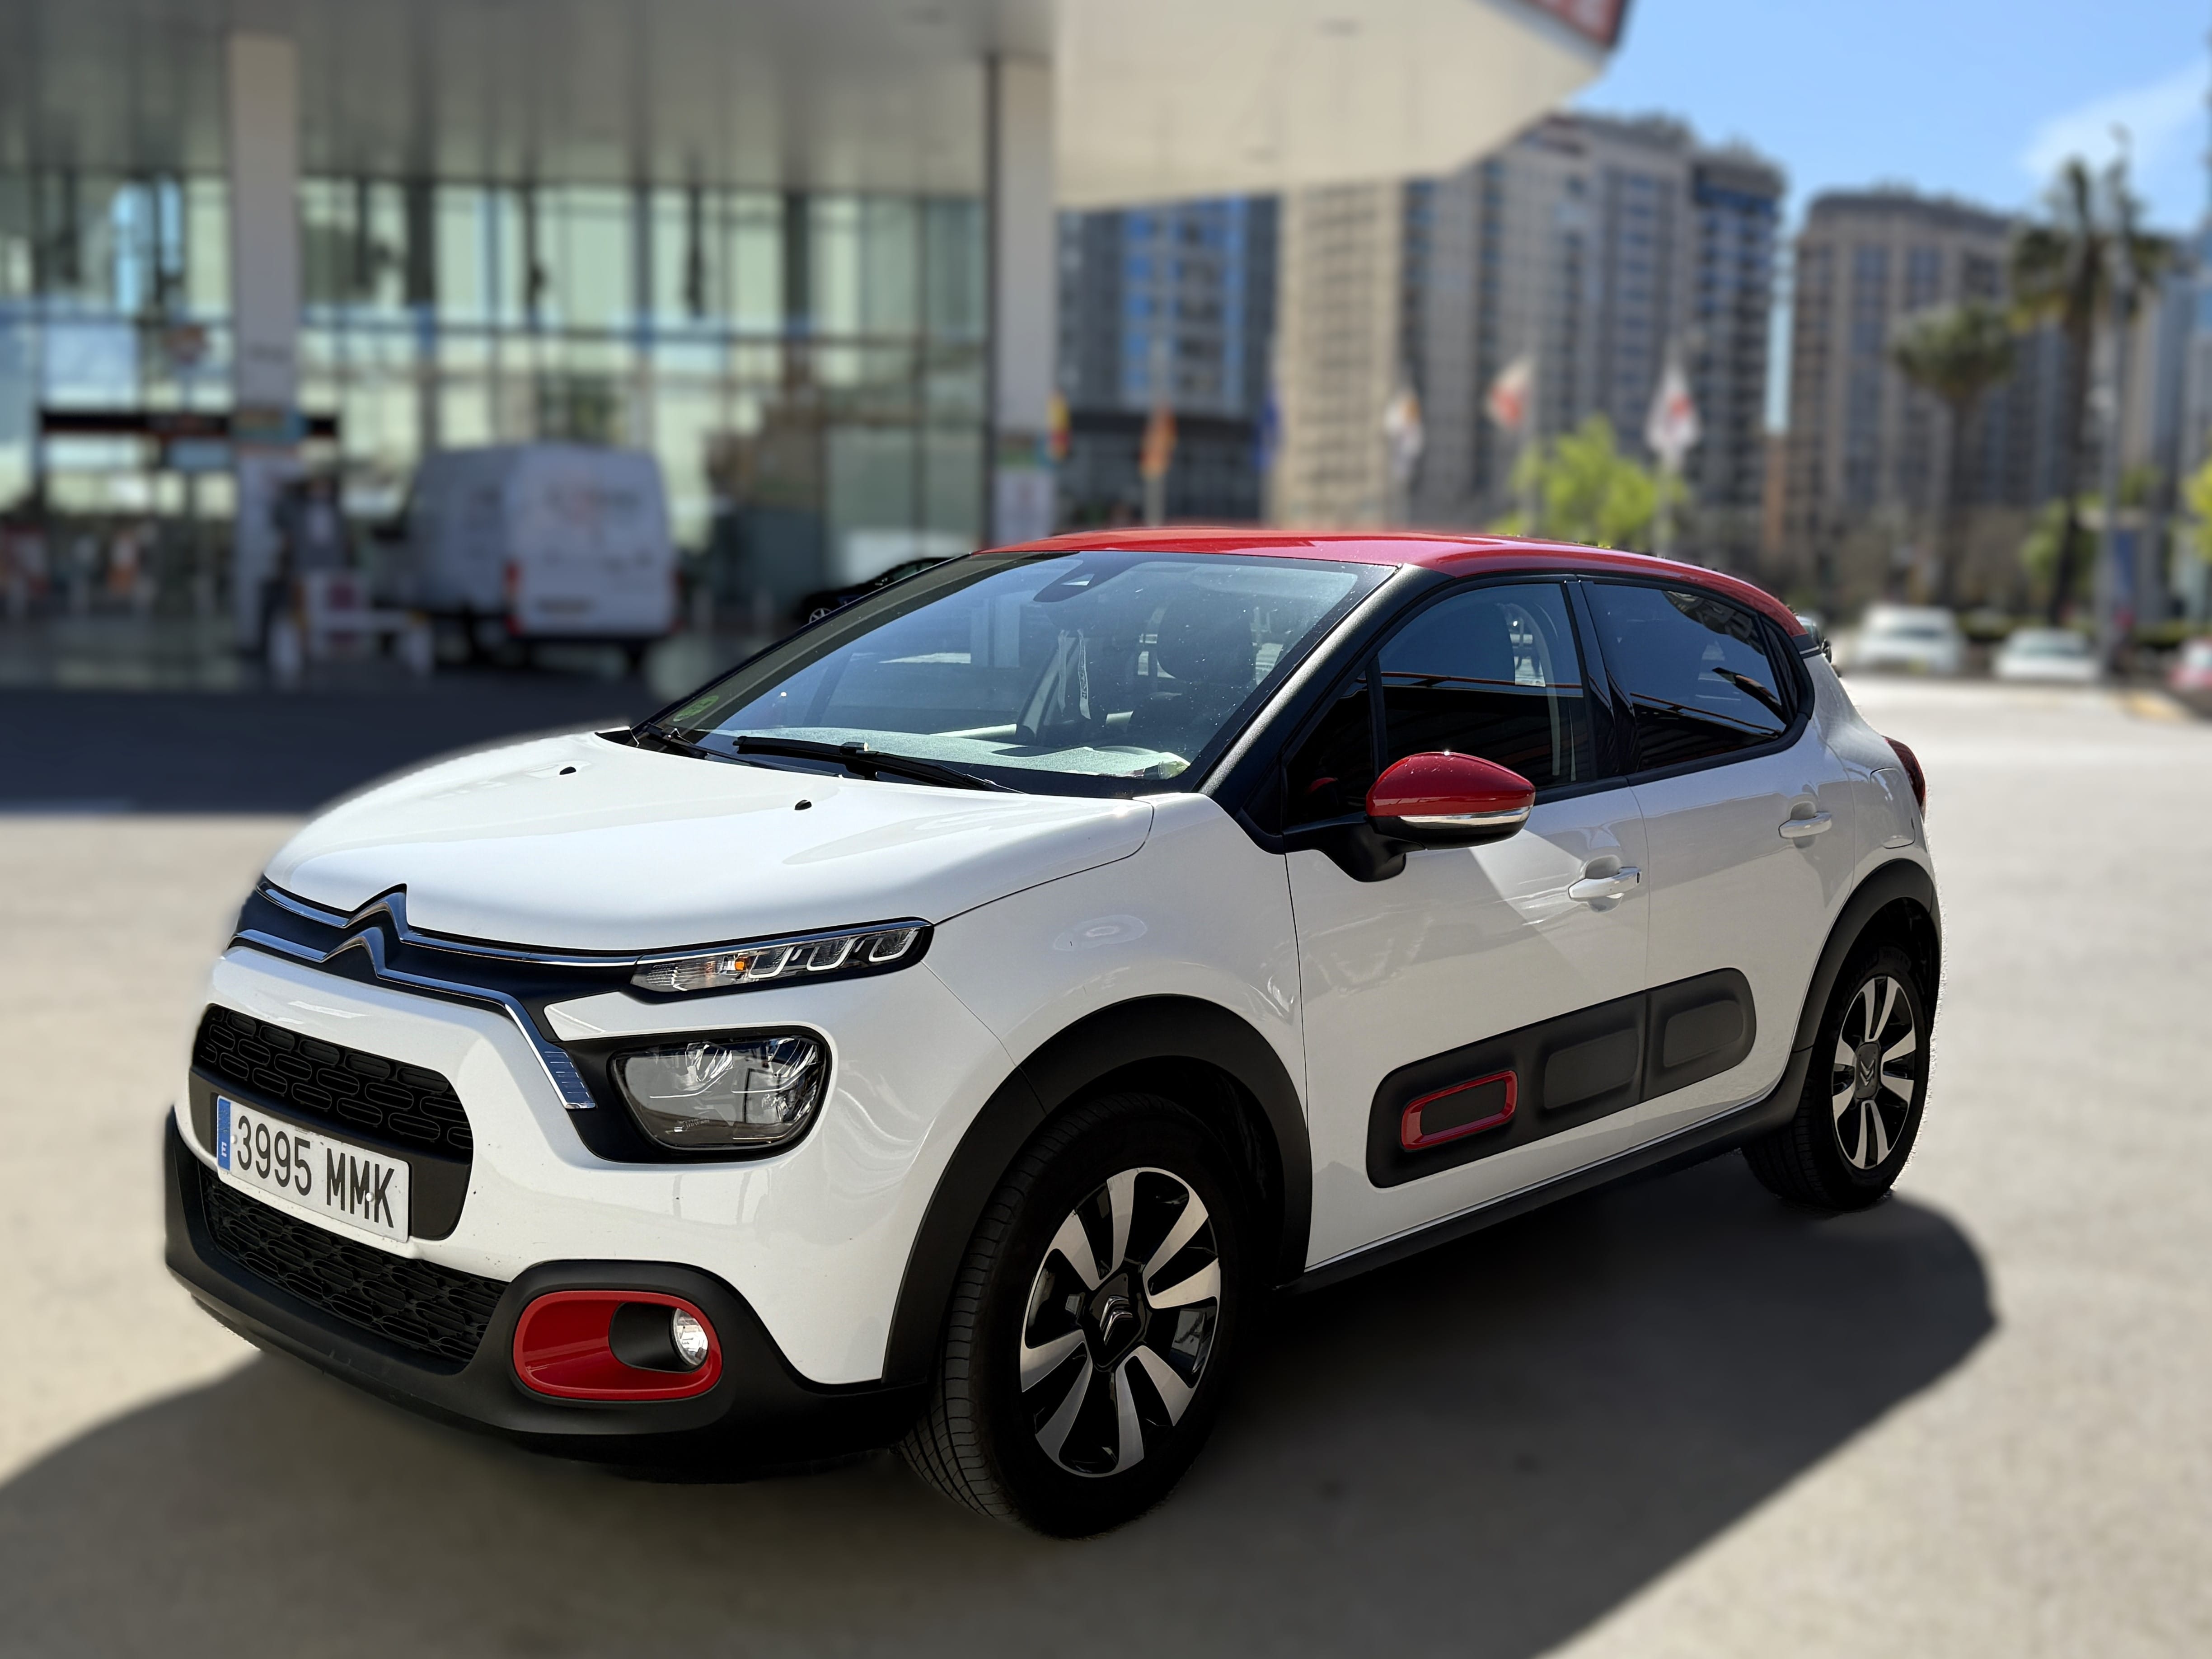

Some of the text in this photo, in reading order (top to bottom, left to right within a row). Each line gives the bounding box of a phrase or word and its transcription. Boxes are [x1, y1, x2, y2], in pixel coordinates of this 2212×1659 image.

[221, 1141, 227, 1157] E
[237, 1115, 395, 1228] 3995 MMK
